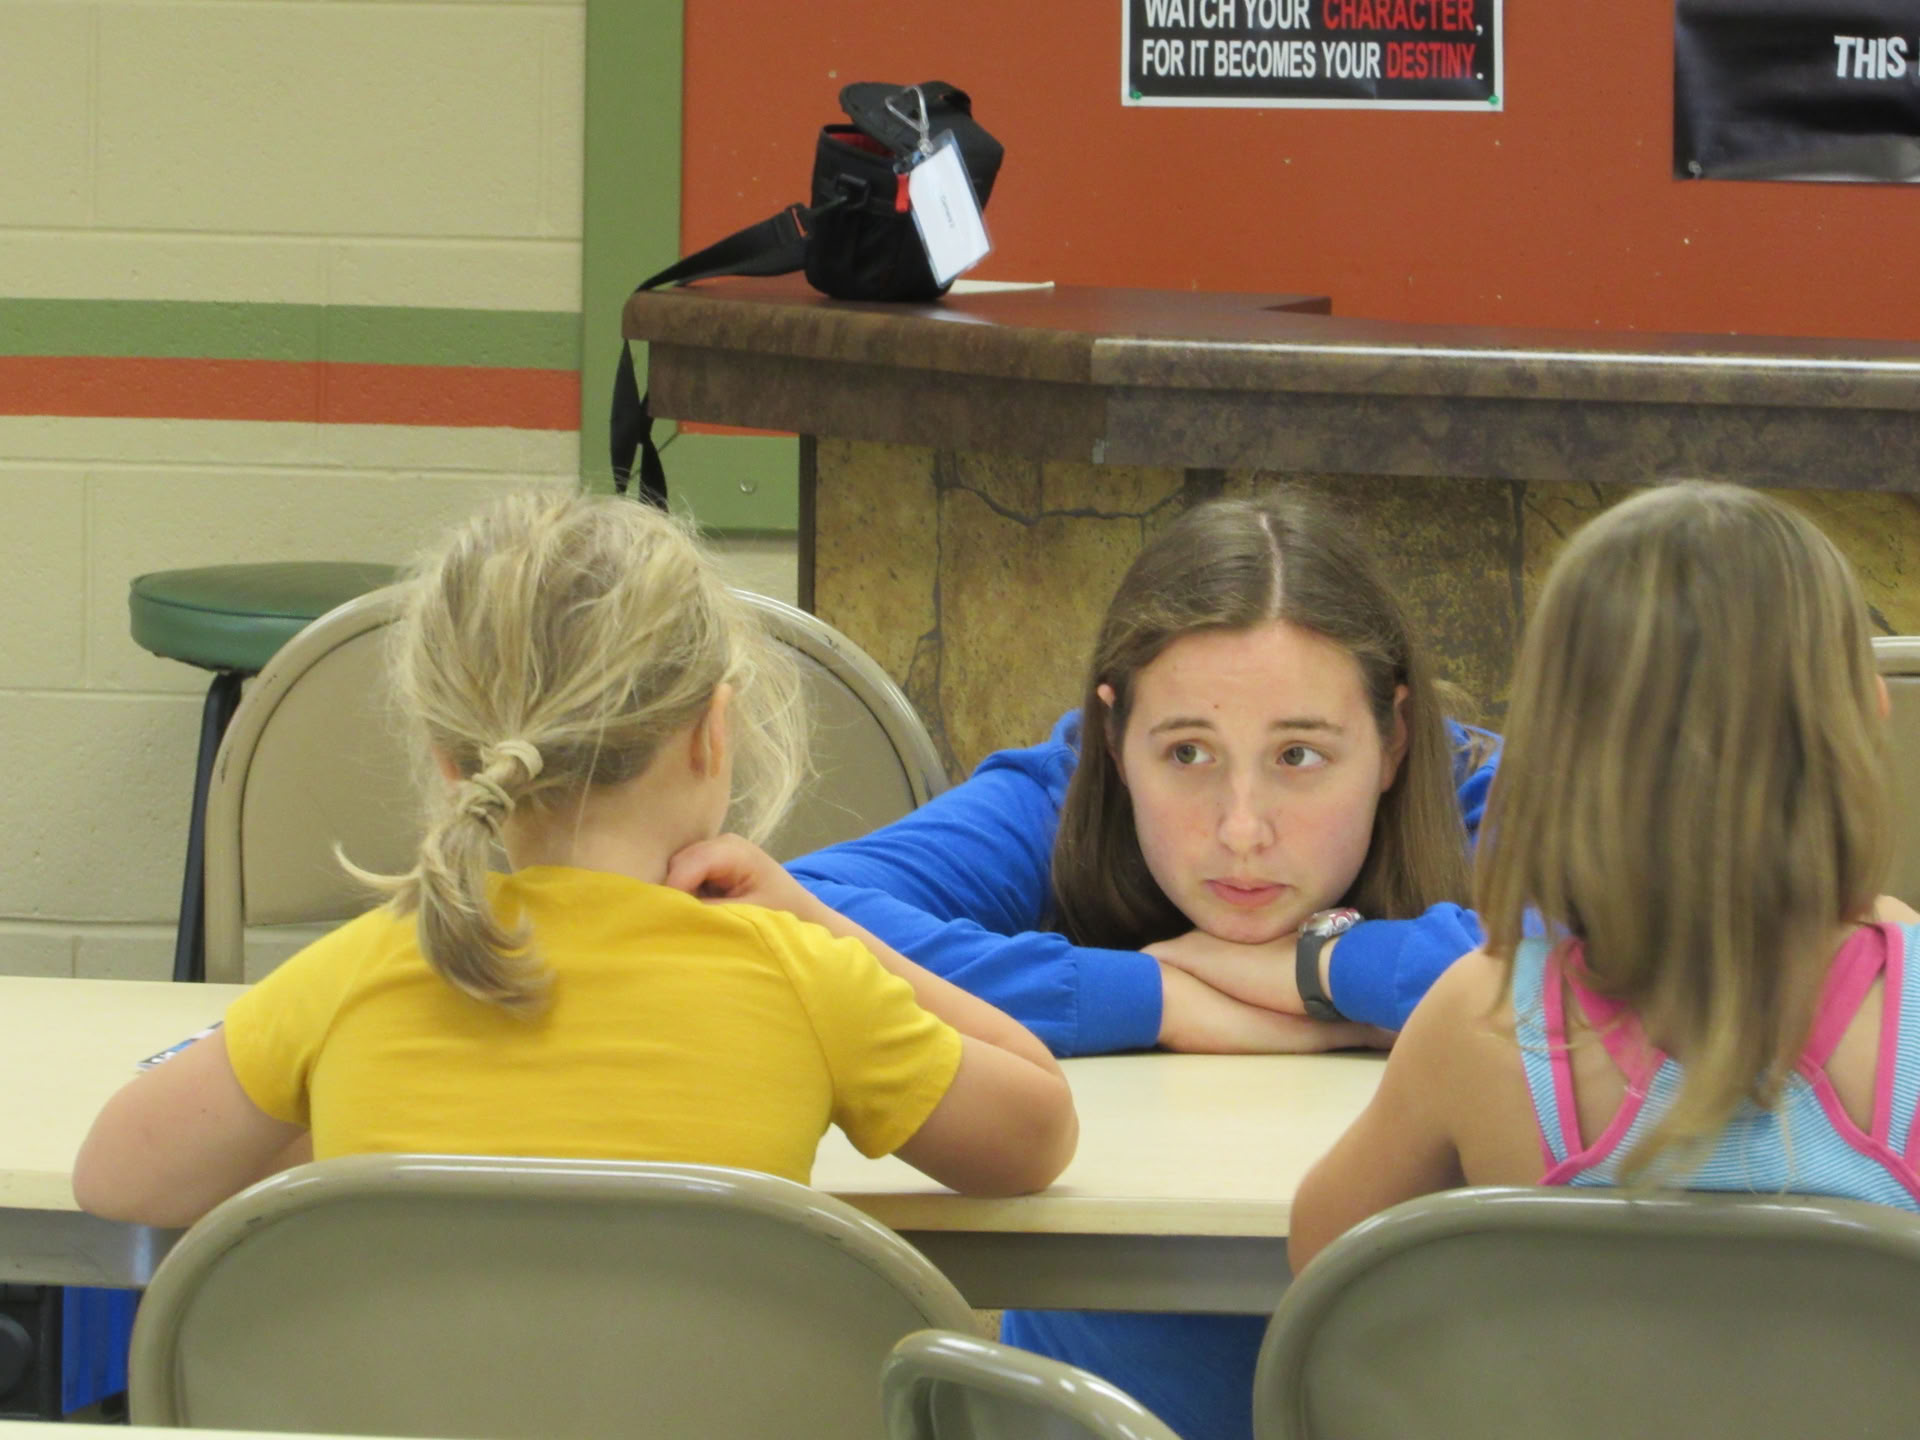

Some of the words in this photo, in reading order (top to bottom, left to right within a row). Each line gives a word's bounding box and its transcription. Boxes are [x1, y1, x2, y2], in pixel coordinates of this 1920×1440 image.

[1144, 0, 1235, 28] WATCH
[1245, 0, 1311, 29] YOUR
[1322, 0, 1484, 36] CHARACTER,
[1142, 39, 1185, 76] FOR
[1190, 40, 1209, 76] IT
[1214, 40, 1317, 78] BECOMES
[1321, 41, 1381, 78] YOUR
[1385, 42, 1484, 79] DESTINY.
[1834, 35, 1908, 79] THIS
